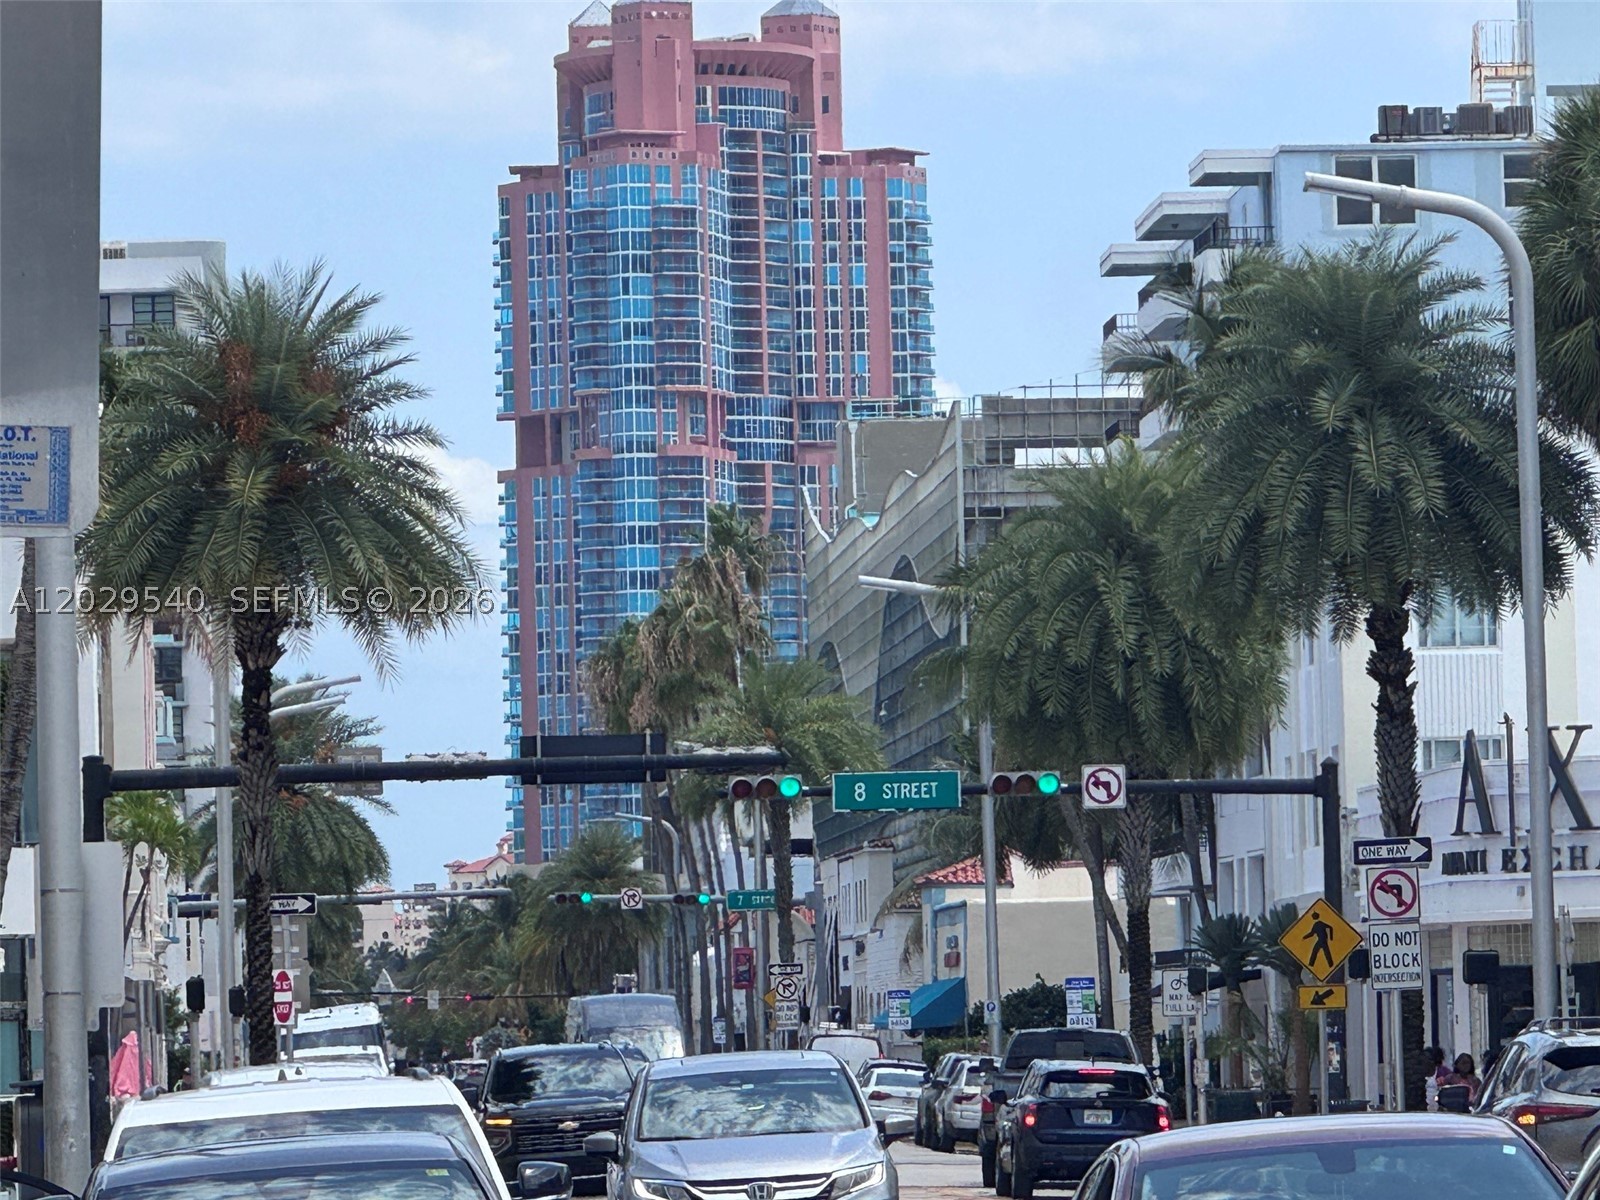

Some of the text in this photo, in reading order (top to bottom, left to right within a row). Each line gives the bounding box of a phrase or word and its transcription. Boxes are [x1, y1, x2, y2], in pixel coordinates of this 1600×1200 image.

[854, 782, 938, 802] 8 STREET
[1361, 845, 1408, 858] ONE WAY
[737, 895, 743, 906] 7
[1372, 930, 1418, 948] DO NOT
[1373, 952, 1421, 969] BLOCK
